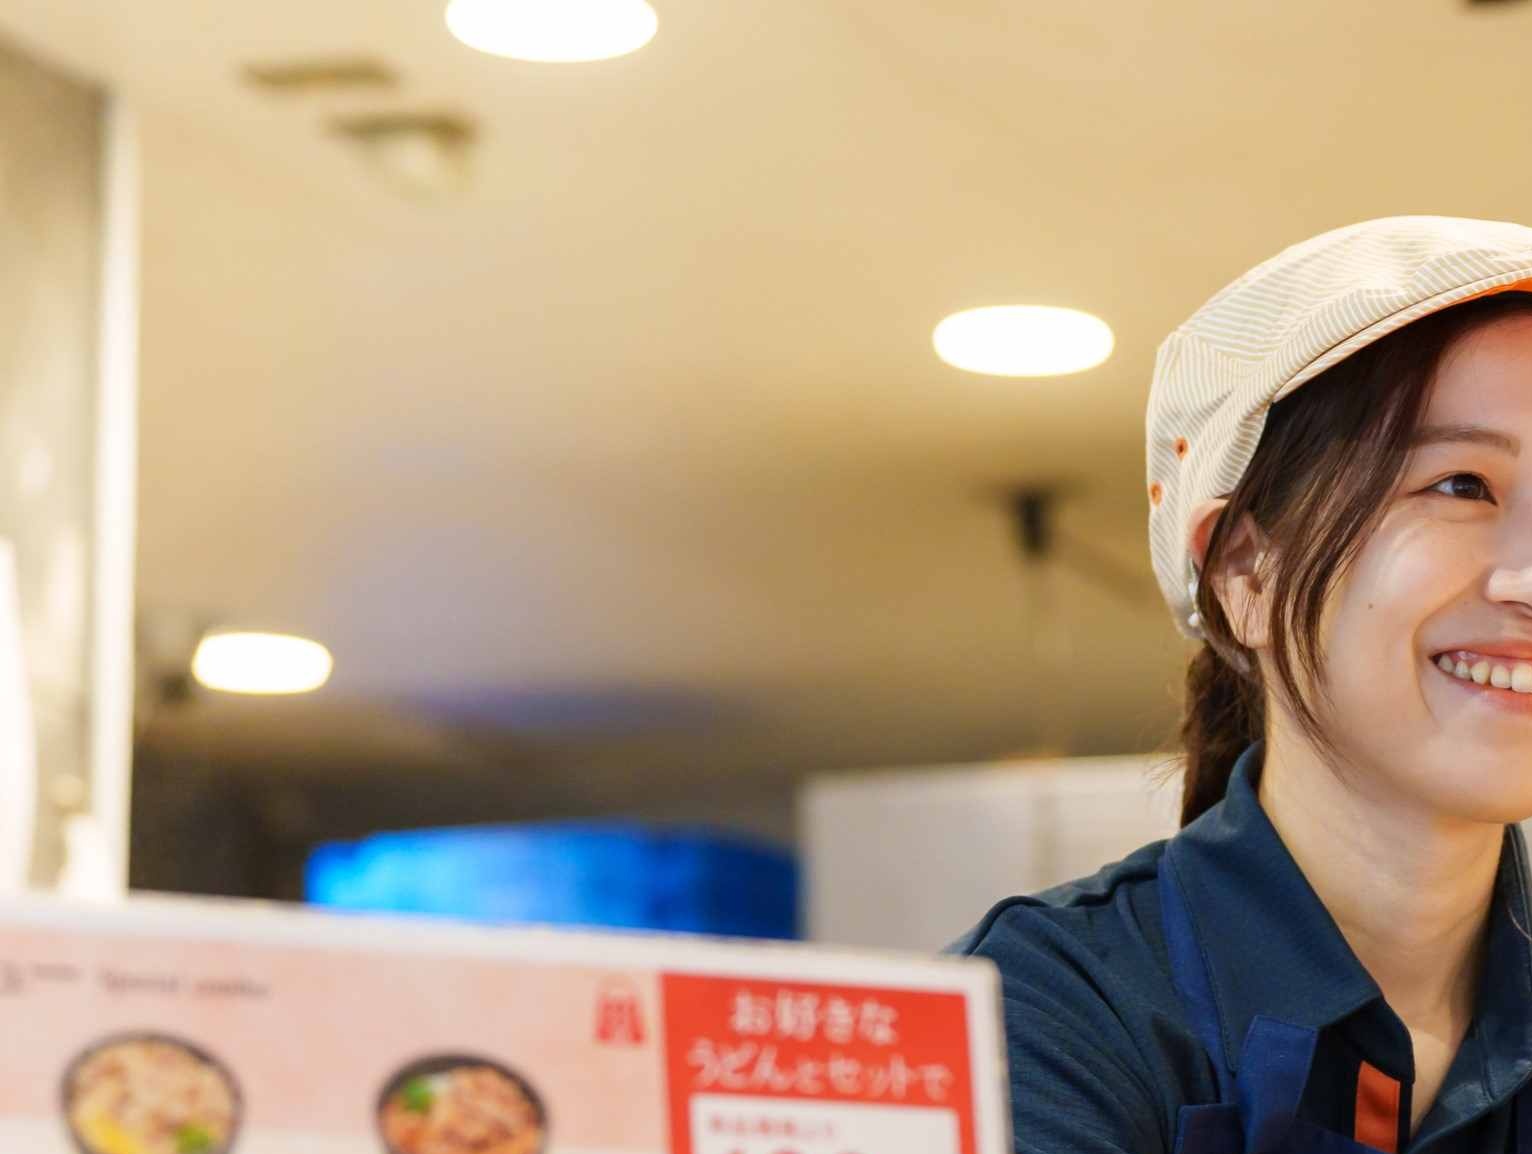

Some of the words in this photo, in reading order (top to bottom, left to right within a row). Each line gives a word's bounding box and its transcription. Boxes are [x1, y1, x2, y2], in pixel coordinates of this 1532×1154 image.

[731, 989, 898, 1044] お好きな
[688, 1038, 953, 1099] うどんとセットで
